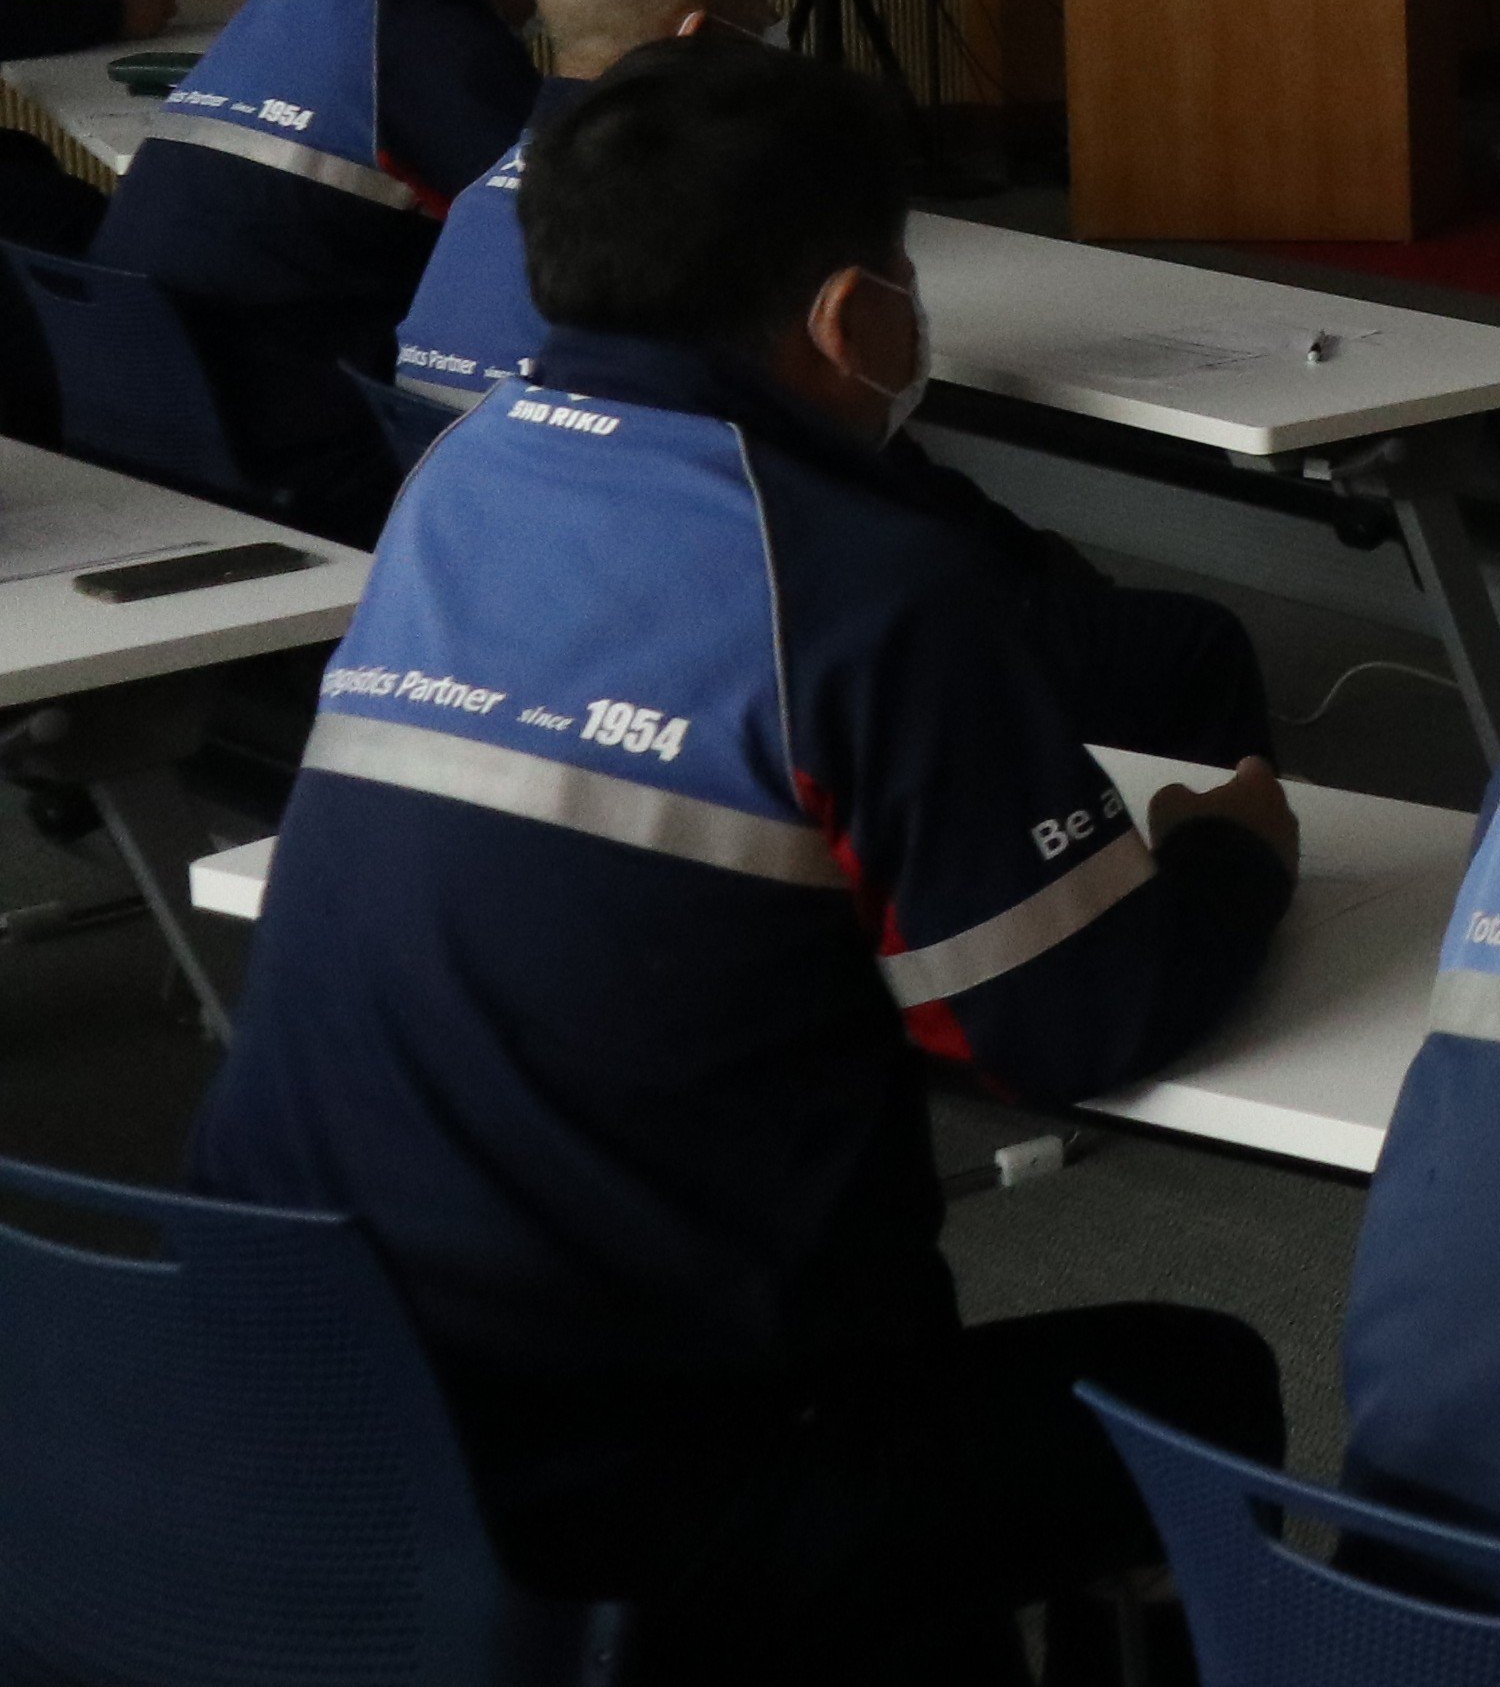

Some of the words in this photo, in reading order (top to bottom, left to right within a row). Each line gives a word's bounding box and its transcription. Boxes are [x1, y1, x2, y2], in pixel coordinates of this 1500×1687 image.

[257, 98, 316, 131] 1954
[428, 349, 477, 376] Partner
[548, 406, 621, 436] RIKU
[395, 670, 508, 715] Partner
[516, 705, 576, 732] since
[579, 698, 692, 762] 1954
[1031, 809, 1096, 861] Be
